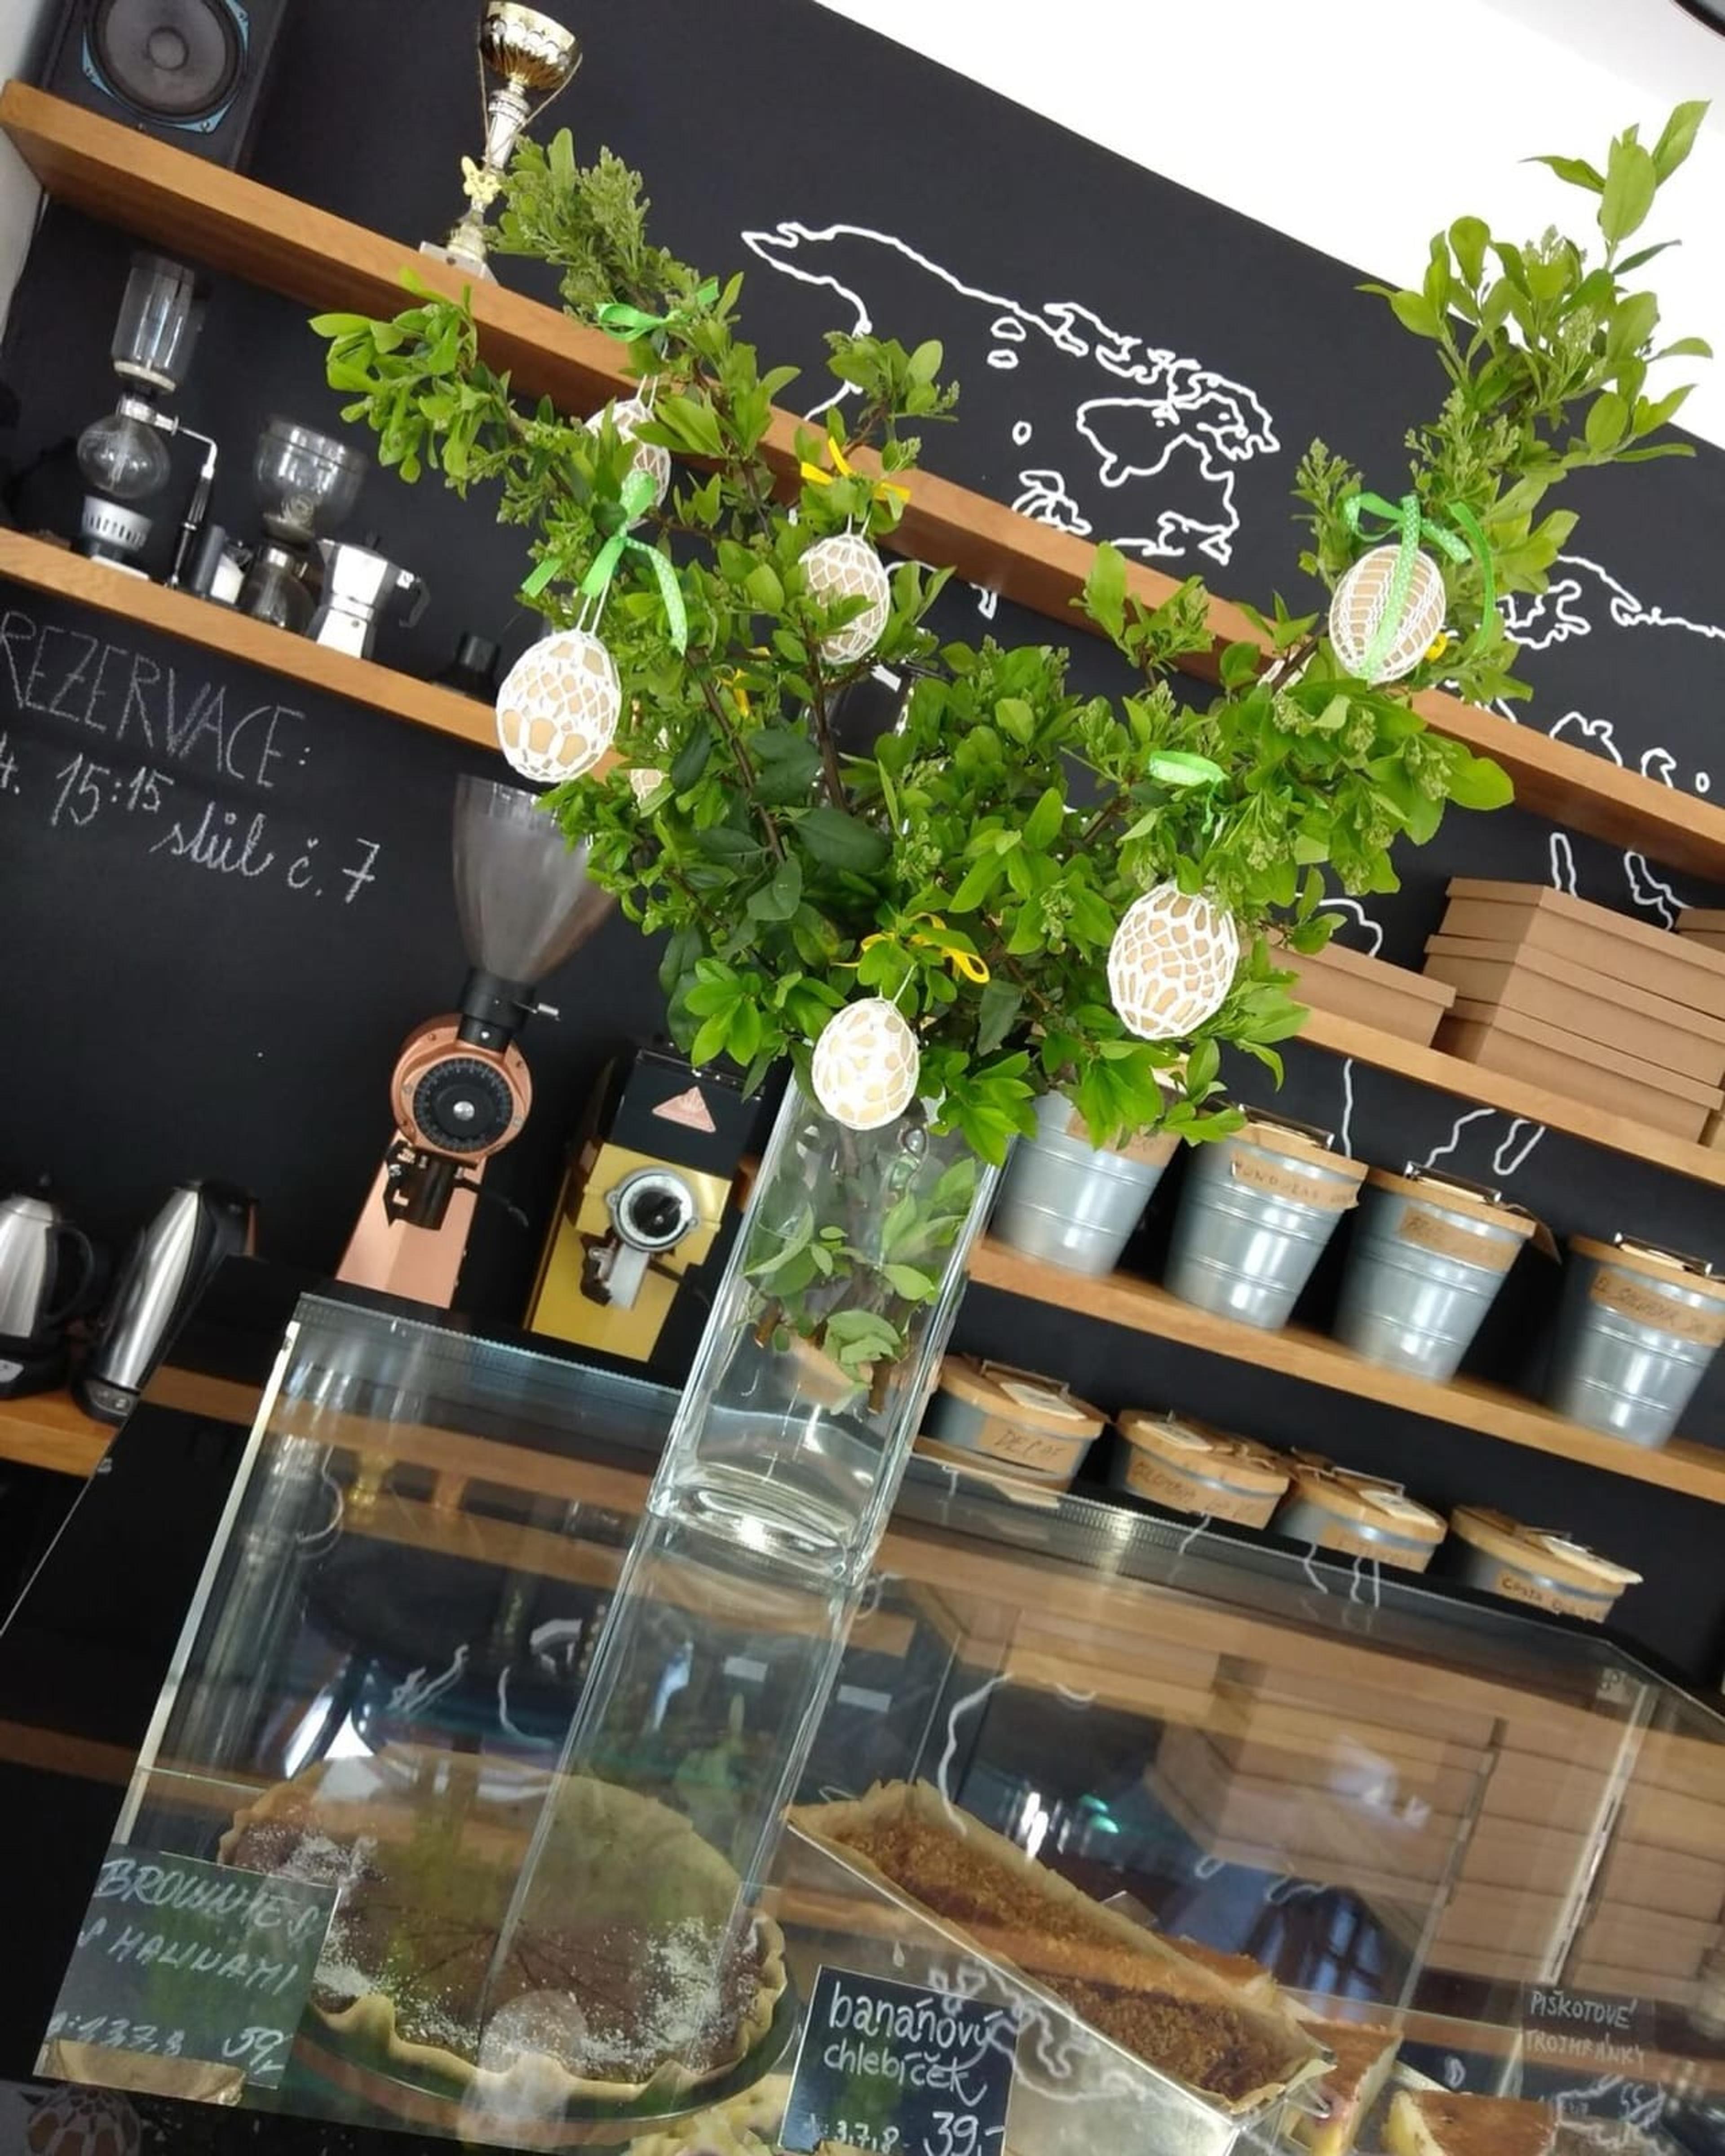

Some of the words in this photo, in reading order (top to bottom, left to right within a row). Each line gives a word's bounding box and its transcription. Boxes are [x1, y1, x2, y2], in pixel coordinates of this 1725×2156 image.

[1, 610, 311, 787] REZERVACE:
[51, 753, 174, 826] 15:15
[149, 801, 273, 876] stůl
[1530, 1989, 1638, 2029] PIŠKOTOVÉ
[823, 2037, 988, 2107] chlebíček
